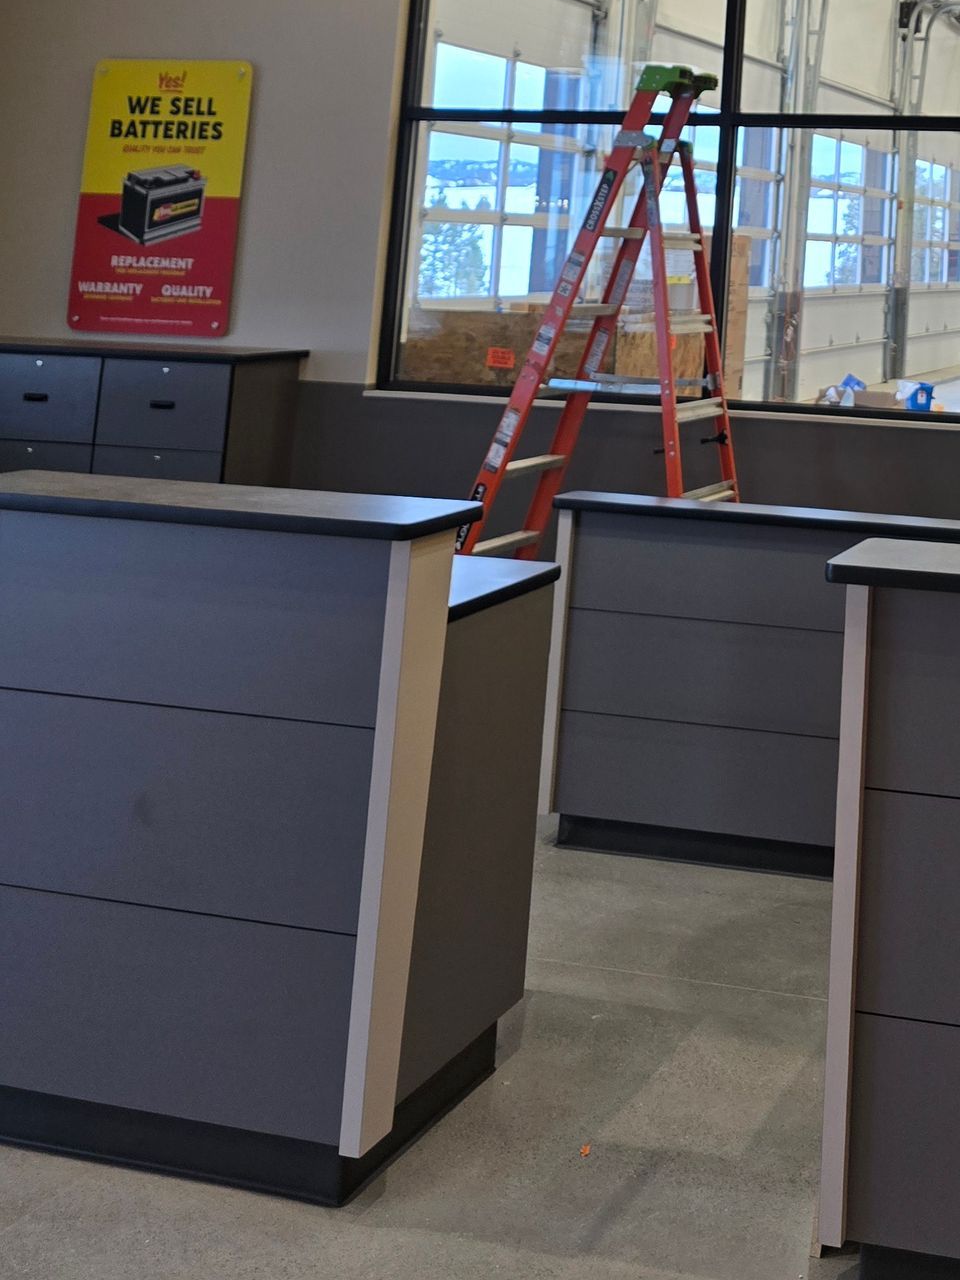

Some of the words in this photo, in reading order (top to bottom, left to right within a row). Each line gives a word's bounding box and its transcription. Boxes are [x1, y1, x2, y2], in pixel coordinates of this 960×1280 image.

[158, 71, 187, 90] Yes!
[127, 96, 162, 115] WE
[169, 97, 217, 116] SELL
[110, 119, 224, 140] BATTERIES
[111, 255, 194, 270] REPLACEMENT
[78, 281, 143, 296] WARRANTY
[161, 284, 213, 298] QUALITY
